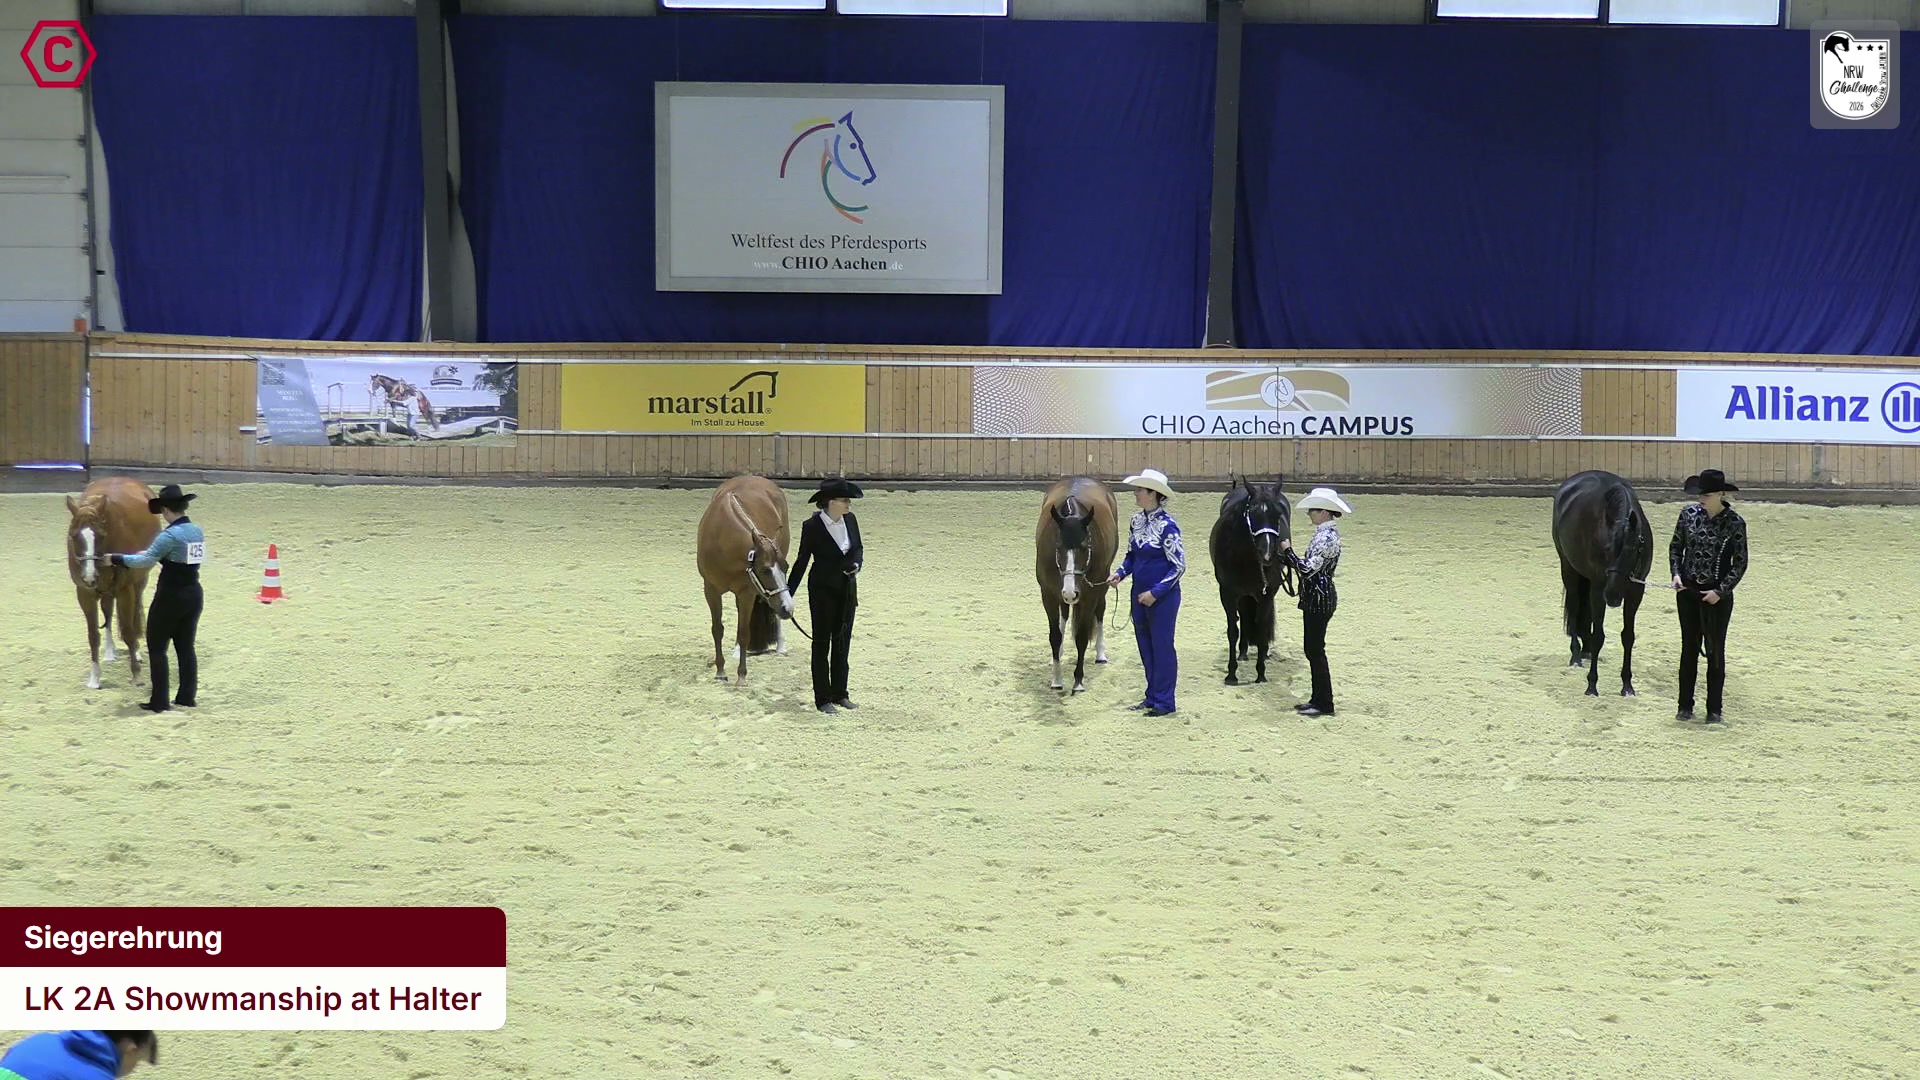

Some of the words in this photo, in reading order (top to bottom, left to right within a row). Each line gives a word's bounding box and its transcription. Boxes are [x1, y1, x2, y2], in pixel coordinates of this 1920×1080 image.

[731, 233, 794, 249] Weltfest
[799, 233, 825, 249] des
[831, 234, 927, 253] Pferdesports
[1725, 385, 1870, 422] Allianz
[691, 418, 702, 426] Im
[704, 418, 723, 426] Stall
[737, 419, 765, 427] Hause
[1142, 415, 1206, 435] CHIO
[1211, 415, 1295, 435] Aachen
[1301, 416, 1414, 436] CAMPUS
[190, 544, 203, 558] 425
